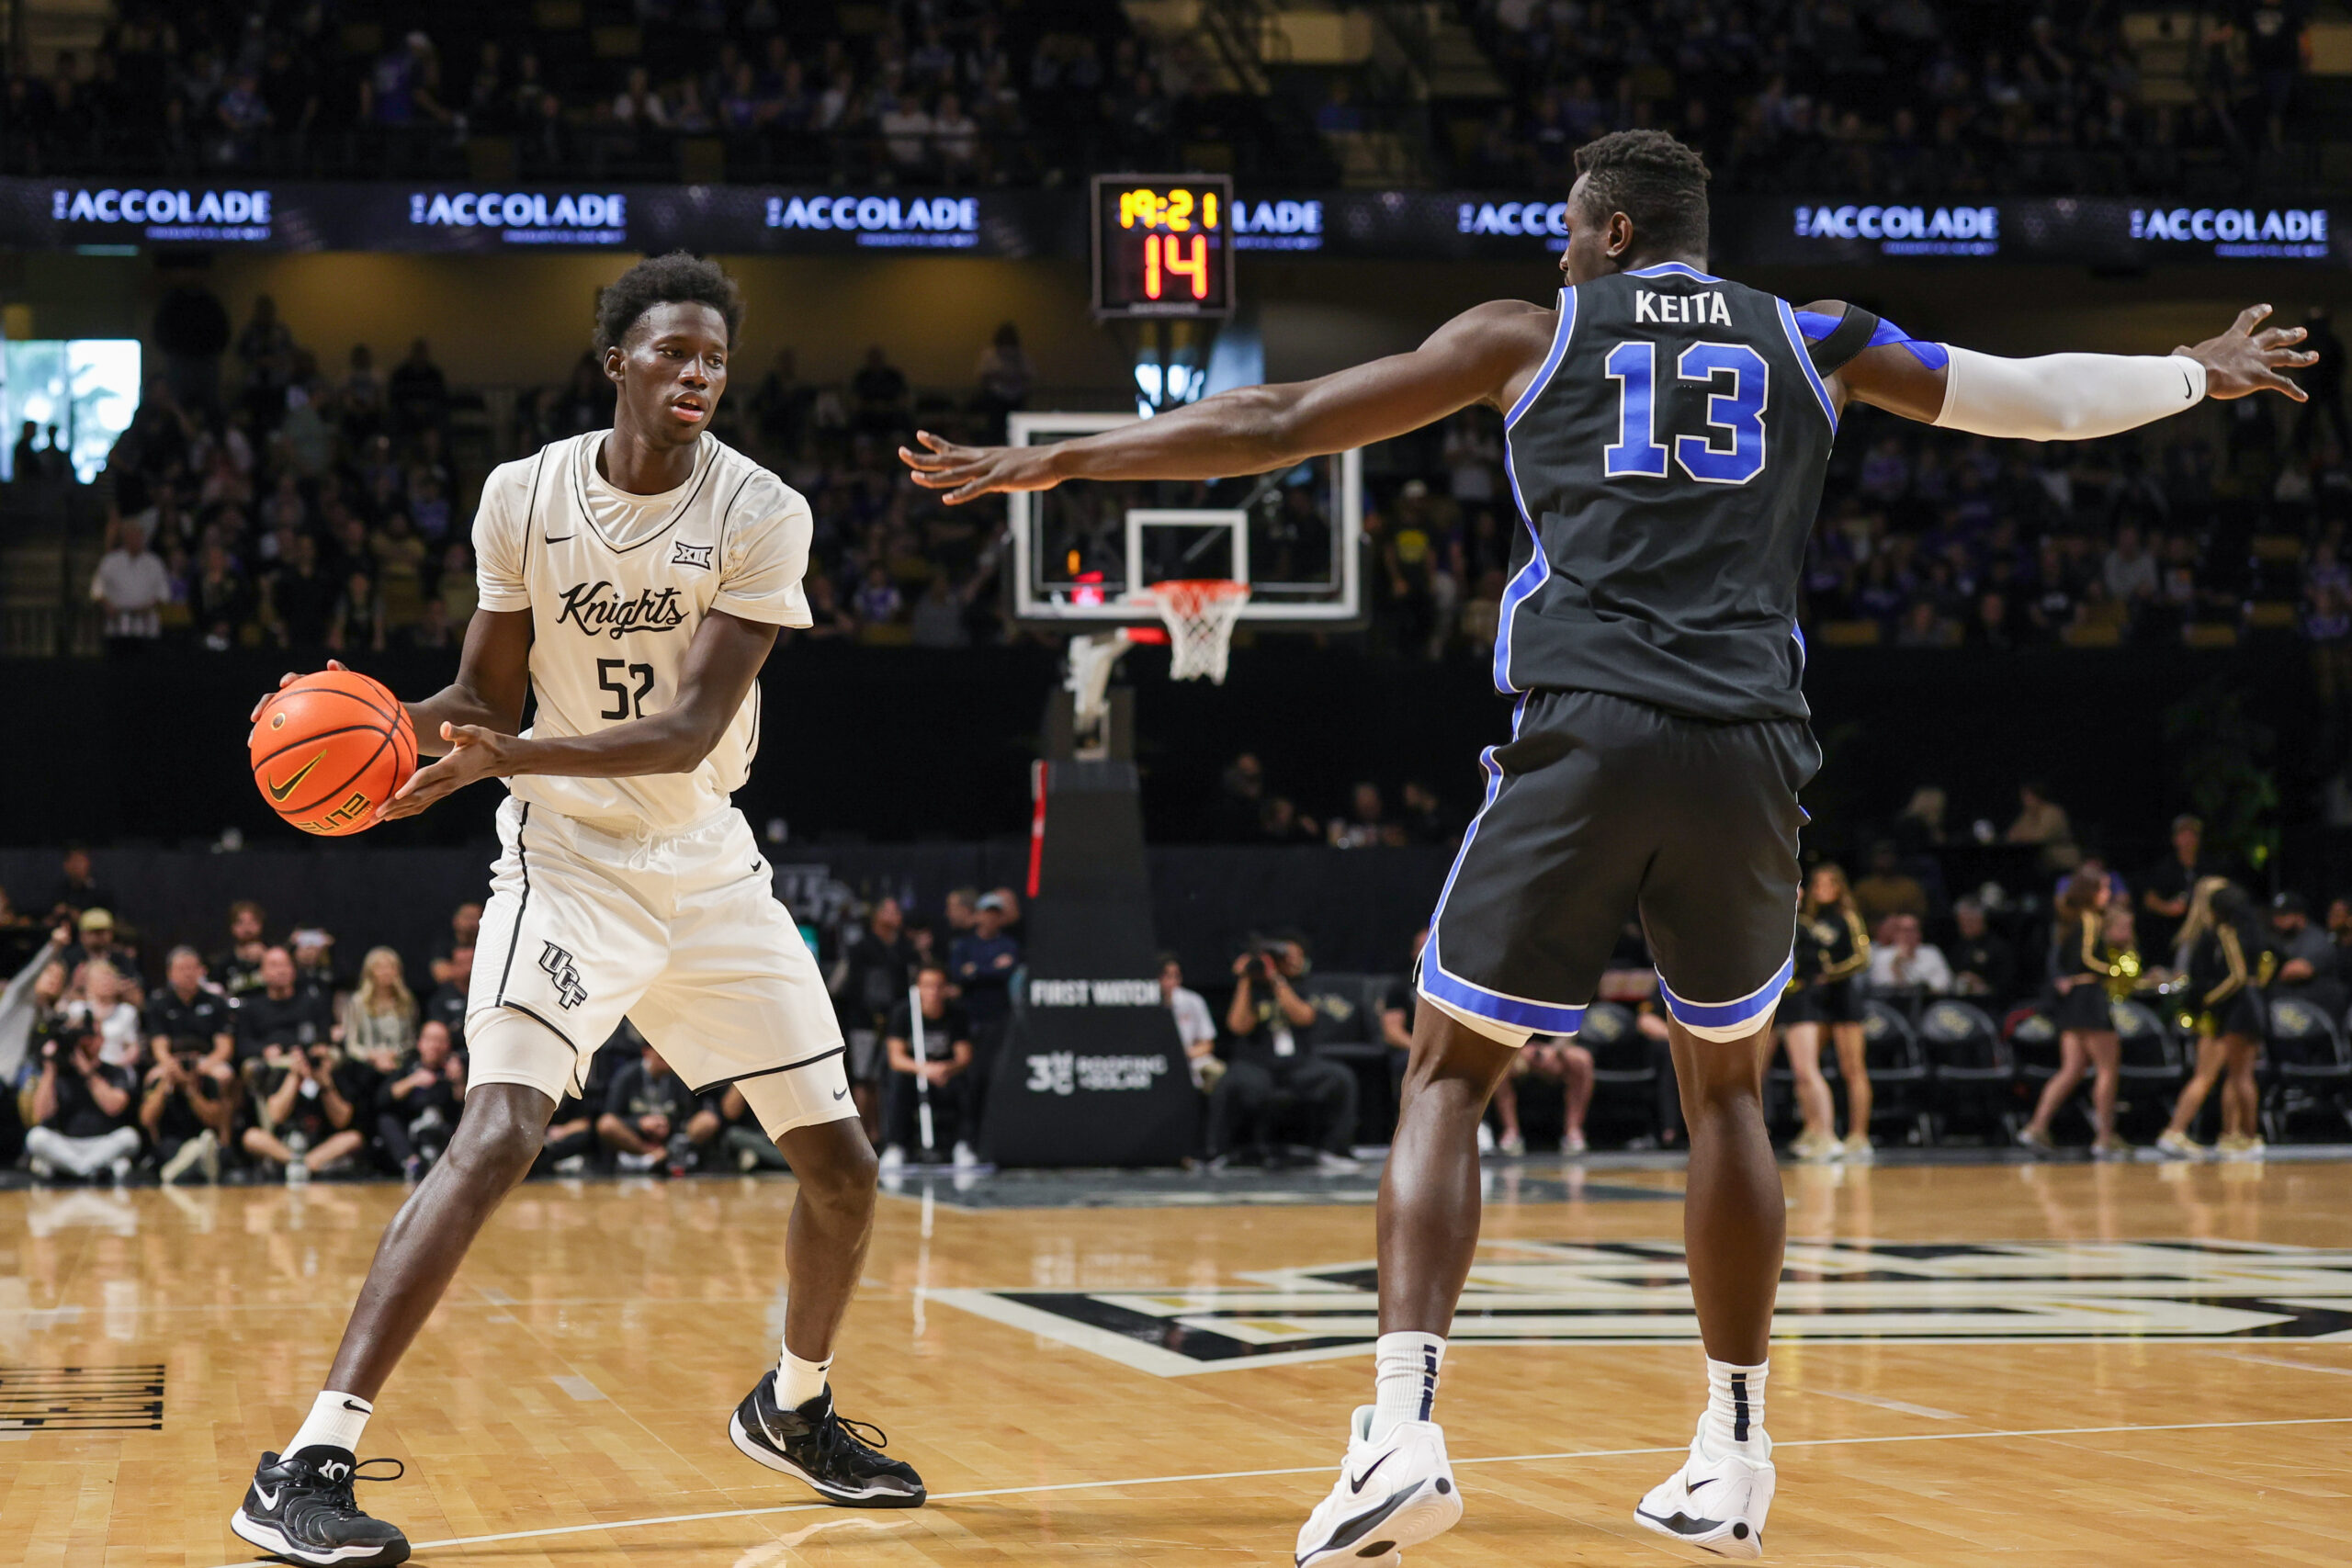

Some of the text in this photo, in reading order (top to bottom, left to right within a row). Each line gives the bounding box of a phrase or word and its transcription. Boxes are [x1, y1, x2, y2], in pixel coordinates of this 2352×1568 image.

[69, 189, 271, 222] ACCOLADE
[426, 192, 627, 227] ACCOLADE
[783, 197, 979, 231] ACCOLADE
[1120, 189, 1217, 231] 19:21
[1231, 200, 1324, 232] LADE
[1473, 202, 1568, 236] ACCO
[1811, 205, 1999, 239] ACCOLADE
[2144, 209, 2328, 241] ACCOLADE
[1145, 233, 1207, 299] 14
[1635, 290, 1732, 326] KEITA
[1604, 341, 1769, 485] 13
[556, 581, 689, 640] Knights
[597, 658, 654, 719] 52
[538, 941, 587, 1010] UCF
[1031, 979, 1160, 1007] FIRST WATCH
